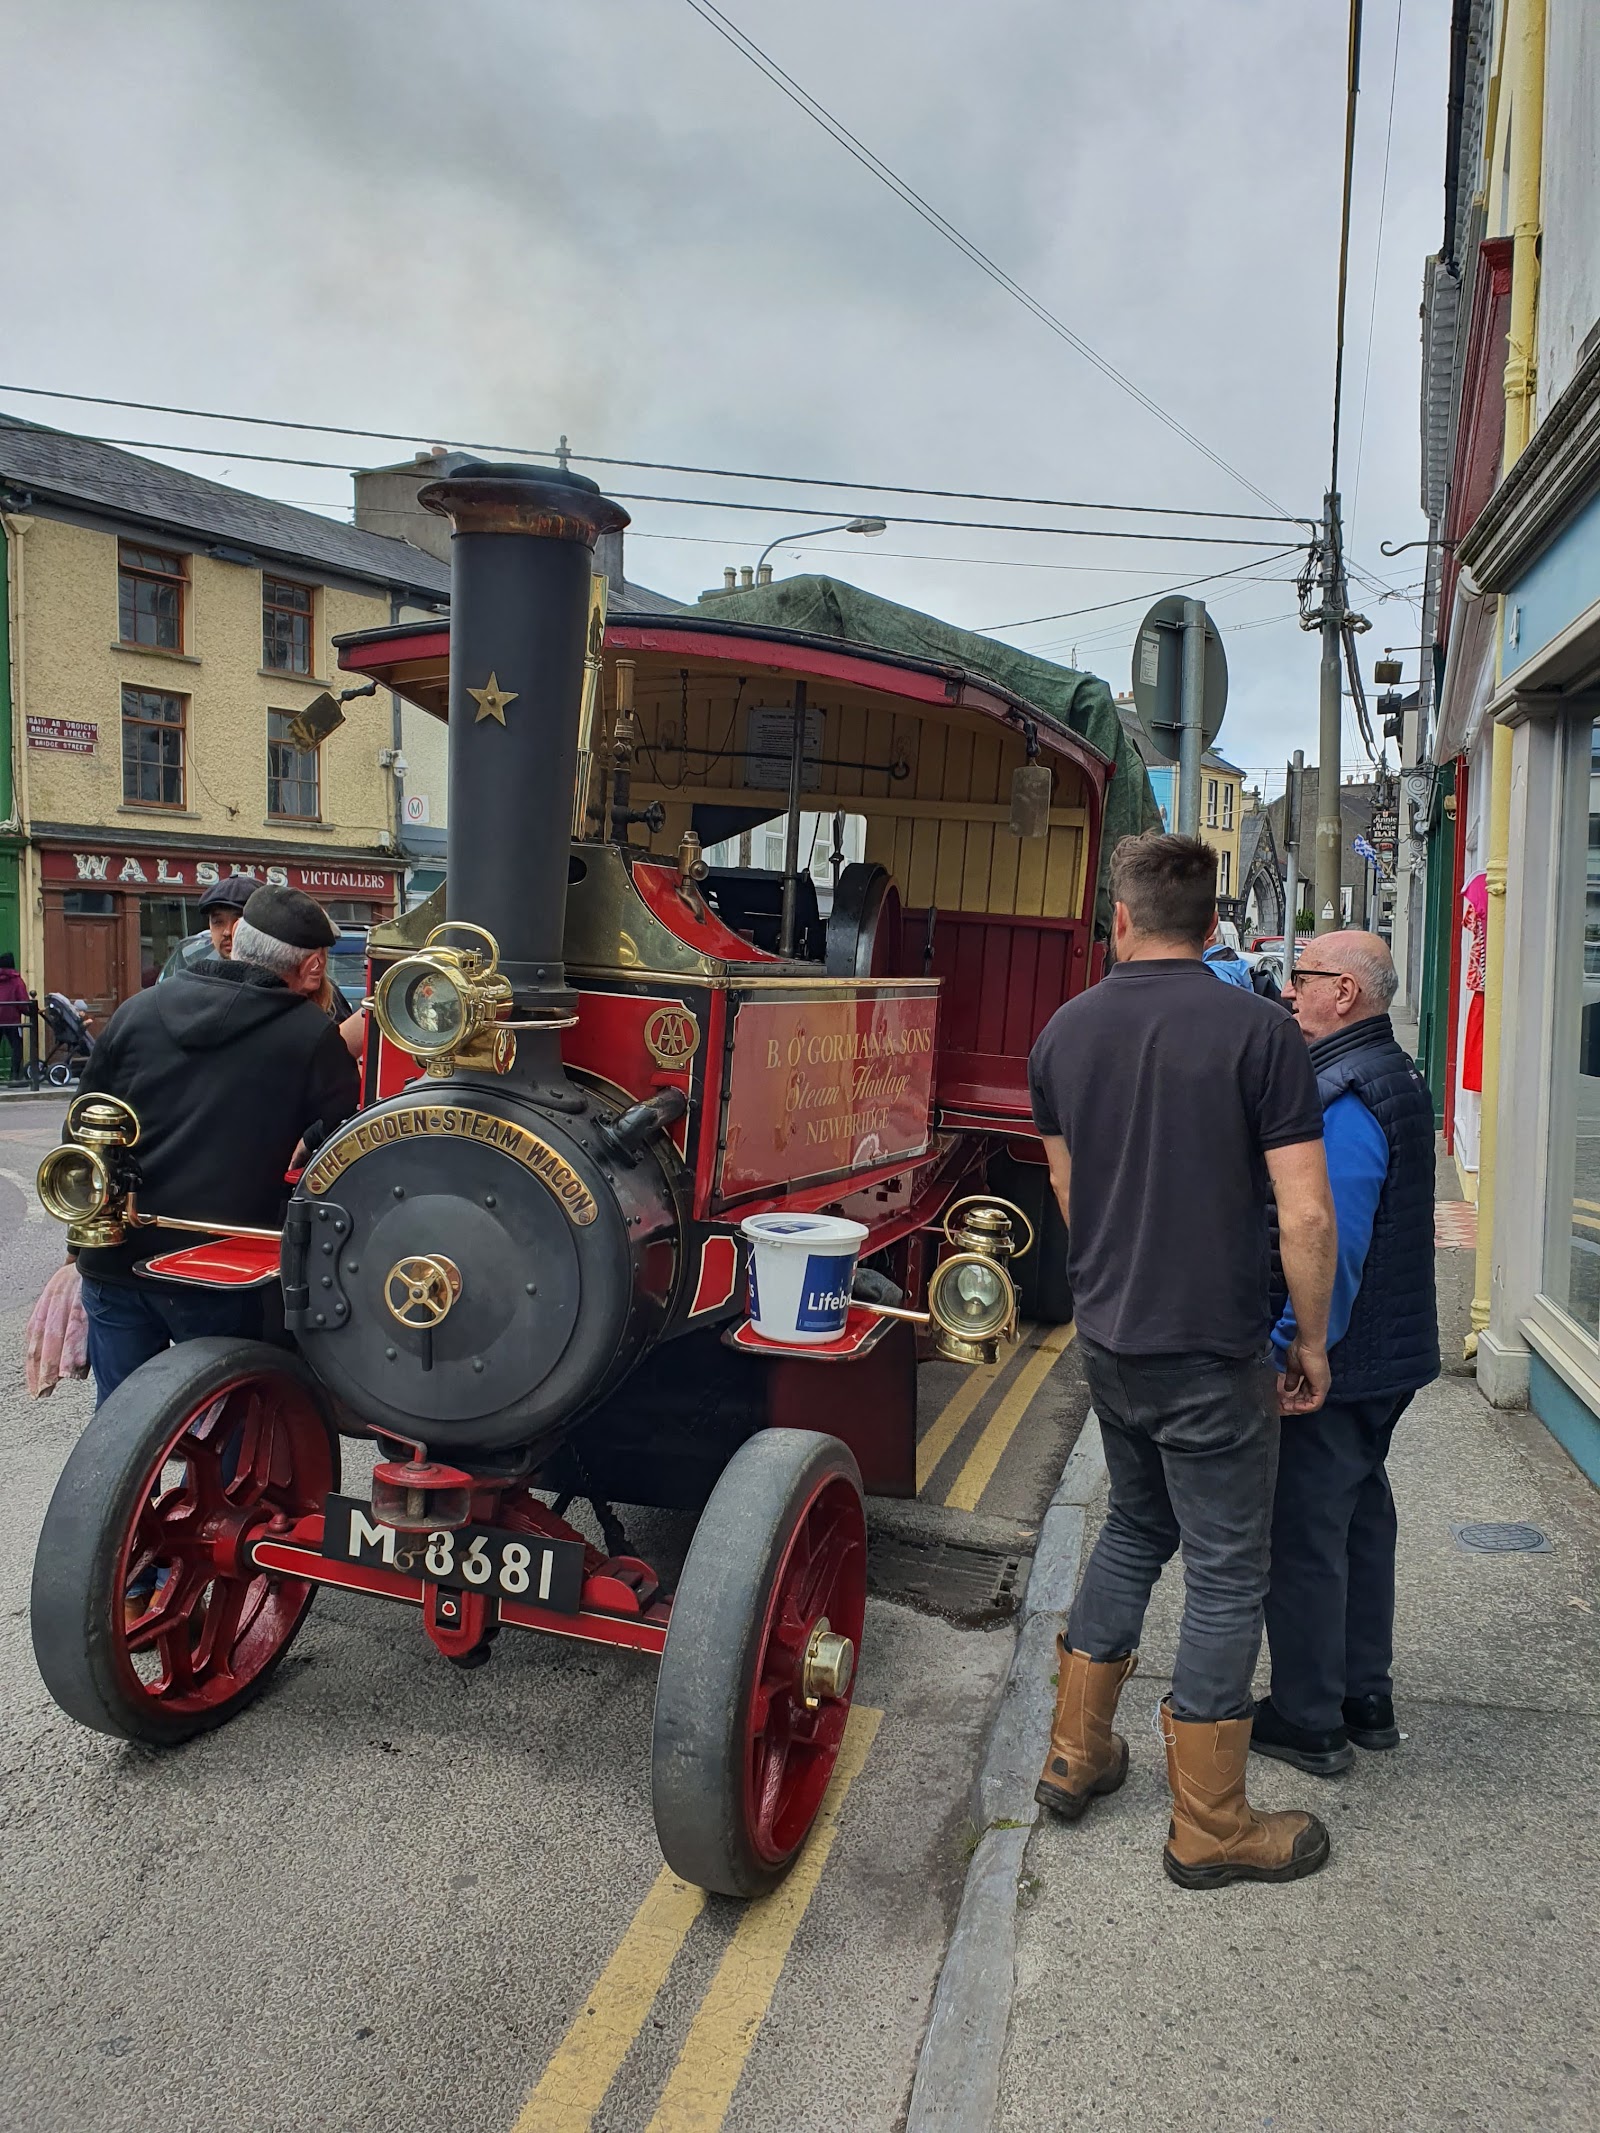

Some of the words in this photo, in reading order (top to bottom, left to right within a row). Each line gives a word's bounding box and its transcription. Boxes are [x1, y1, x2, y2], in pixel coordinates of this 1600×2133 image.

[31, 725, 58, 735] BRIDGE
[63, 729, 92, 739] STREET
[34, 739, 58, 748] BRIDGE
[62, 742, 88, 751] STREET
[73, 853, 289, 888] WALSH'S
[300, 869, 385, 889] VICTUALLERS
[766, 1039, 781, 1069] B.
[900, 1027, 932, 1055] SONS
[785, 1071, 841, 1112] Steam
[846, 1062, 911, 1104] Haulage
[806, 1106, 891, 1146] NEWBRIDGE
[308, 1142, 351, 1187] THE
[442, 1109, 523, 1152] STEAM
